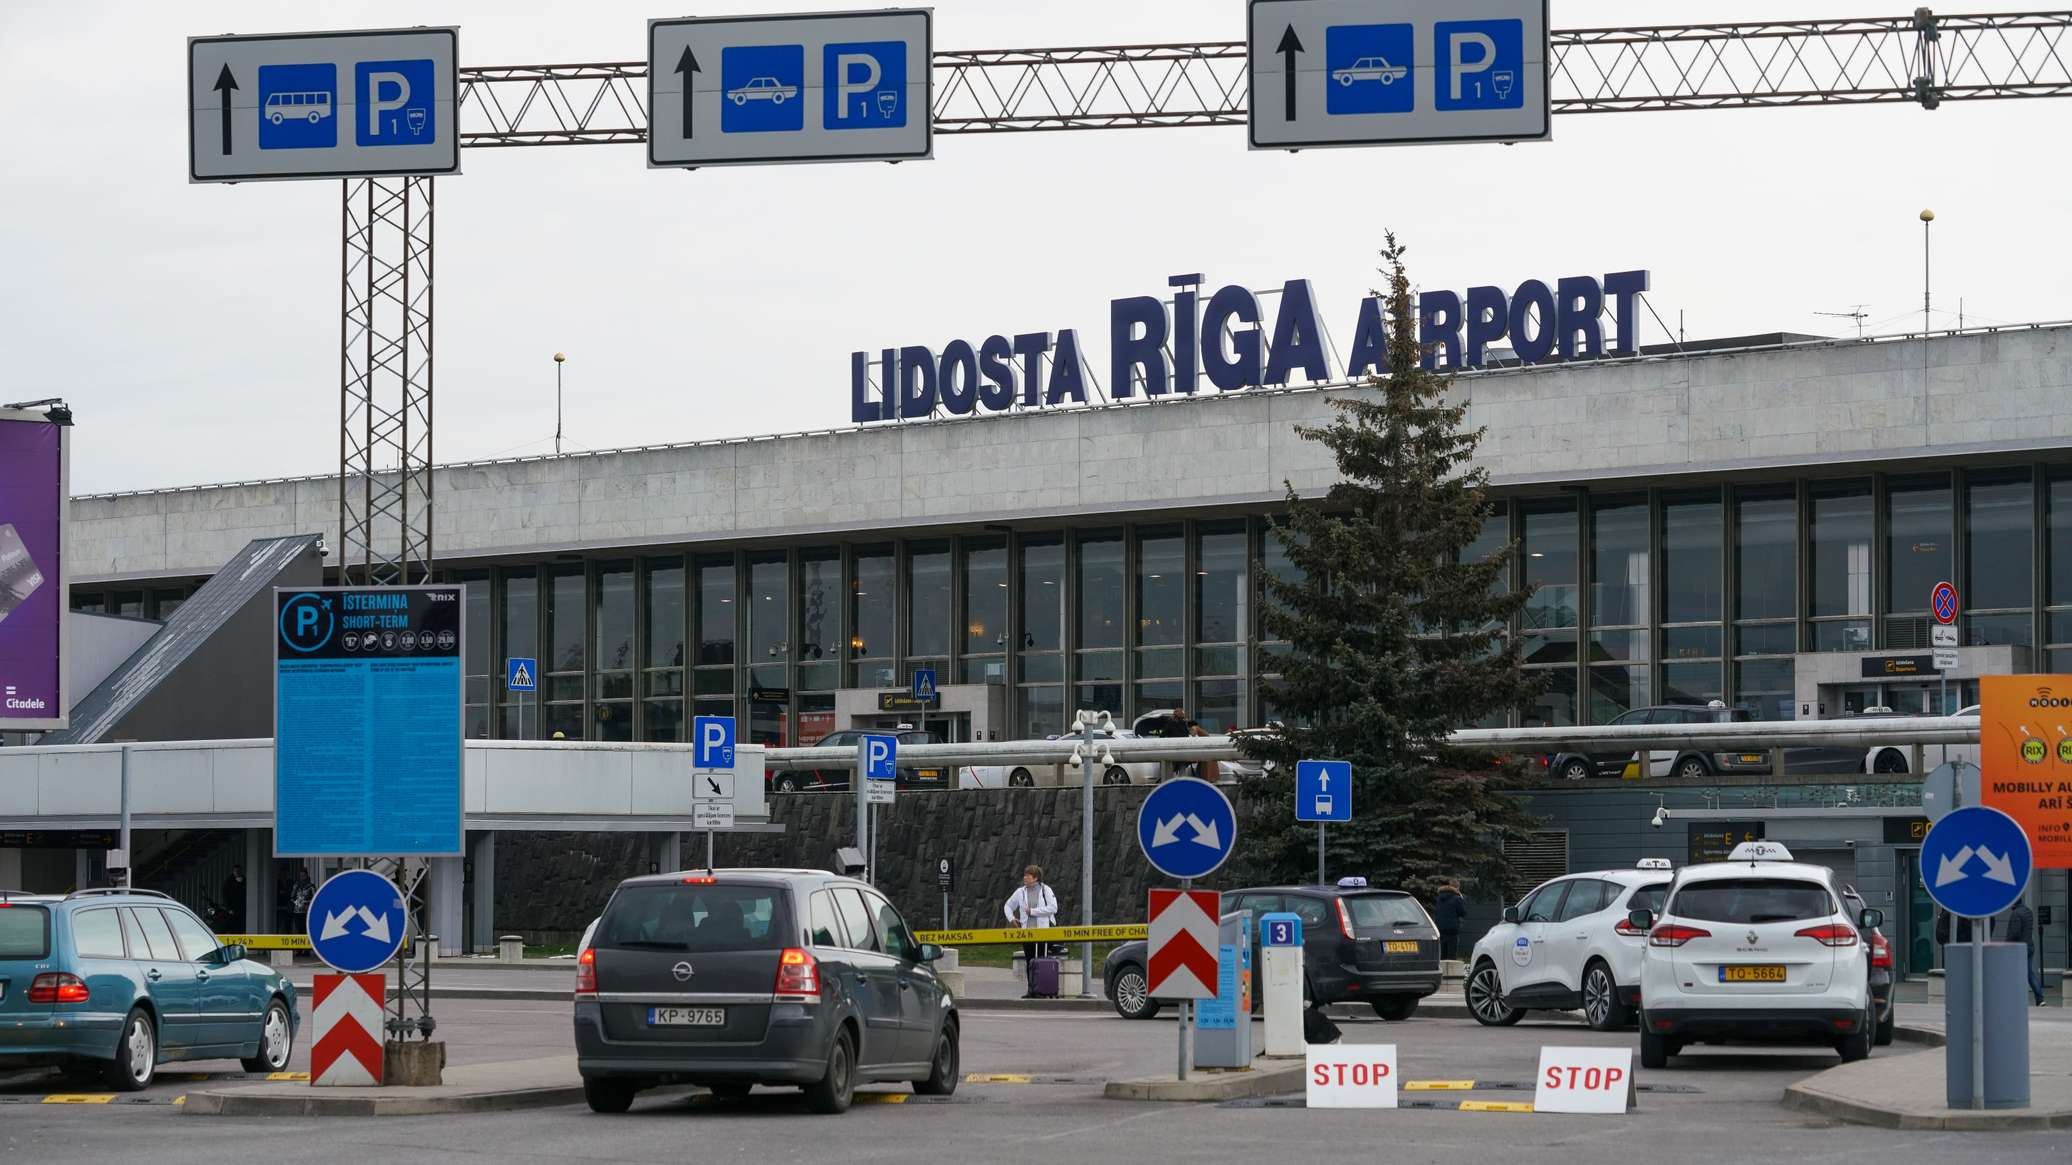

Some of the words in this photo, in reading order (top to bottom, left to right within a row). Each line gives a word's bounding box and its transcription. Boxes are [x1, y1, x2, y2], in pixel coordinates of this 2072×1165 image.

[1449, 32, 1497, 100] P
[1474, 81, 1481, 98] 1
[837, 53, 881, 119] P
[860, 101, 867, 118] 1
[368, 71, 411, 136] P
[391, 118, 398, 135] 1
[851, 328, 1089, 423] LIDOSTA
[1110, 272, 1334, 400] RĪGA
[1347, 269, 1651, 378] ARPORT
[342, 592, 408, 612] ĪSTERMIŅA
[296, 605, 319, 636] P
[342, 615, 408, 629] SHORT-TERM
[6, 698, 46, 709] Citadele
[703, 723, 726, 762] P
[2025, 745, 2043, 756] RIX
[869, 741, 890, 773] P
[1993, 782, 2054, 793] MOBILLY
[2038, 796, 2063, 809] ARĪ
[2038, 823, 2062, 832] INFO
[919, 933, 936, 942] BEZ
[937, 931, 974, 942] MAKSAS
[1016, 930, 1027, 939] 24
[1063, 929, 1072, 938] 10
[1073, 928, 1090, 937] MIN
[1092, 927, 1114, 937] FREE
[1115, 927, 1126, 936] OF
[1128, 926, 1149, 936] CHA
[1276, 924, 1287, 942] 3
[291, 937, 307, 945] MIN
[658, 1009, 723, 1024] KP-9765
[1313, 1063, 1390, 1086] STOP
[1546, 1066, 1623, 1090] STOP
